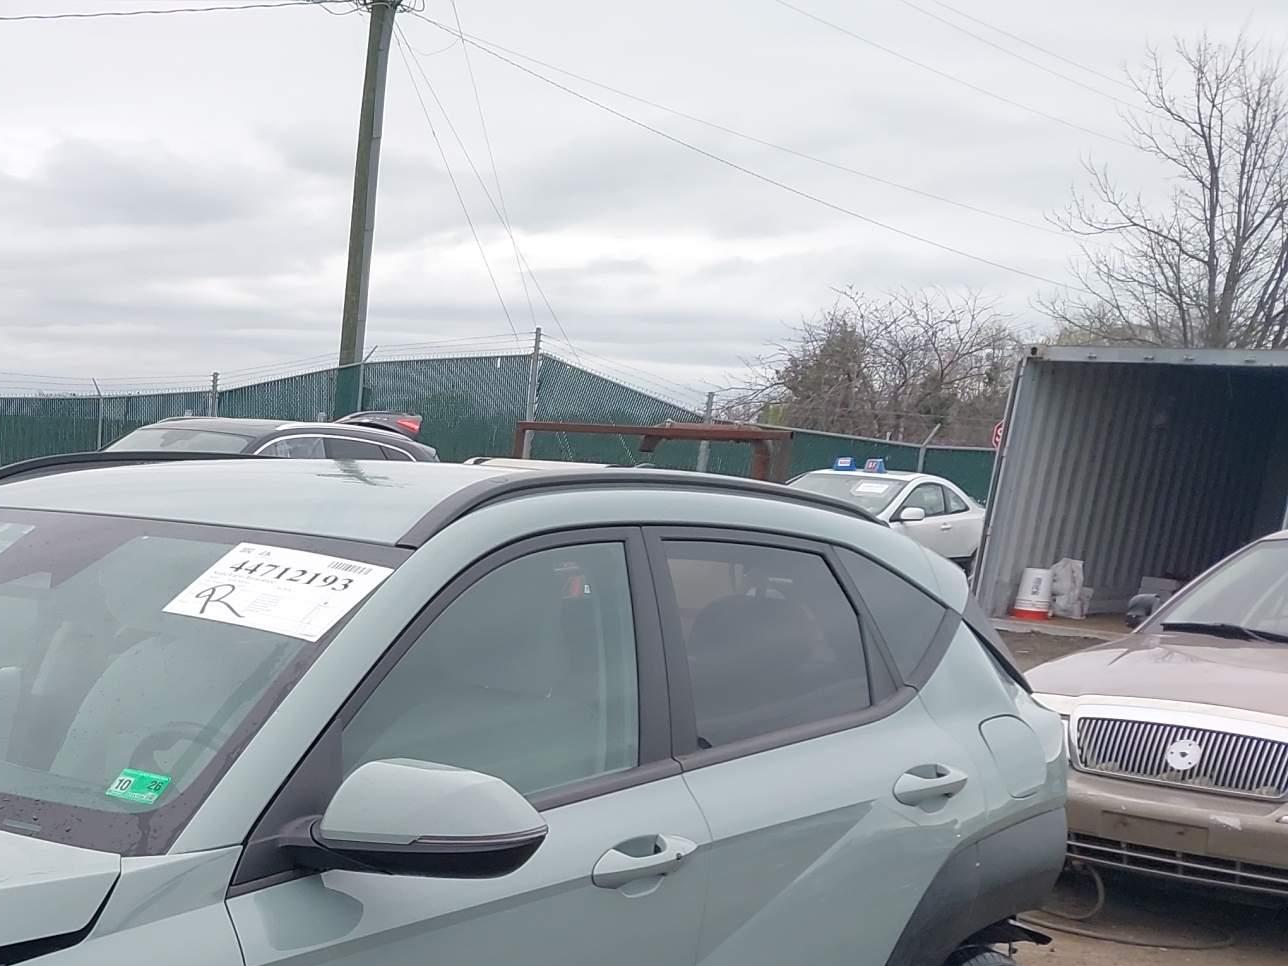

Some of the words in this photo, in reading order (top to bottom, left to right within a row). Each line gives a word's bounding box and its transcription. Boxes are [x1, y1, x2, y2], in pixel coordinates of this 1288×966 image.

[229, 559, 354, 592] 44712193
[195, 583, 245, 618] R
[115, 779, 132, 791] 10
[147, 780, 163, 792] 26
